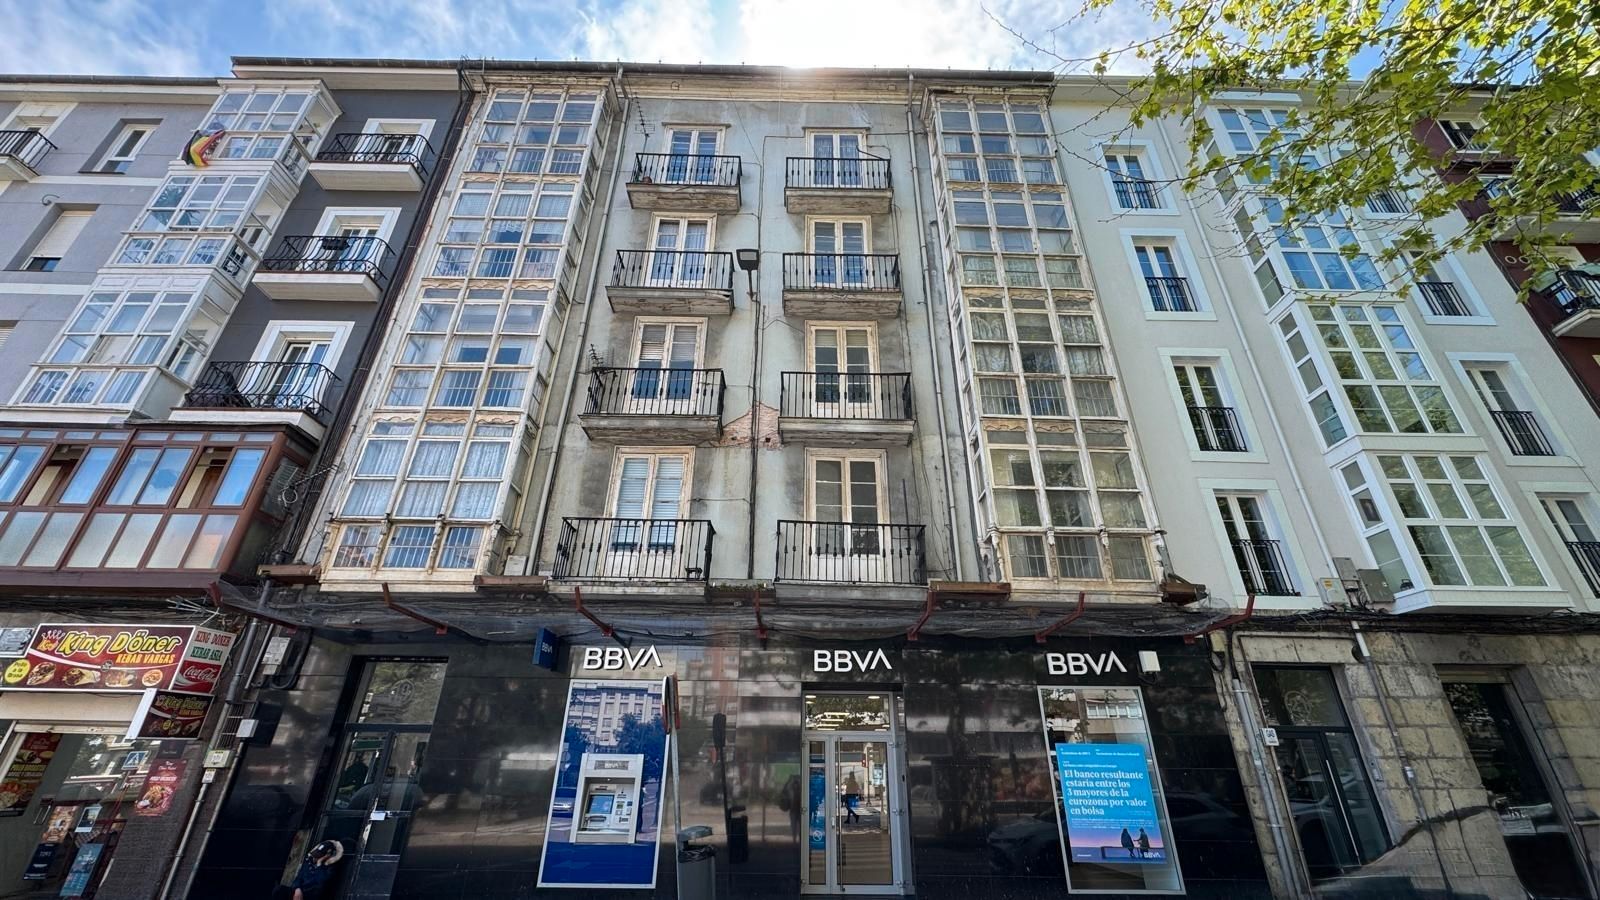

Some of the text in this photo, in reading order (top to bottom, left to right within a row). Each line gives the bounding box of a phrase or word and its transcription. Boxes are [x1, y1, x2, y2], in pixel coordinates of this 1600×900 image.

[56, 631, 109, 656] King
[108, 629, 181, 653] Döner
[195, 631, 211, 644] KING
[541, 642, 553, 654] BBVA
[116, 653, 177, 664] KEBAB VARGAS
[583, 644, 663, 671] BBVA
[813, 648, 892, 672] BBVA
[1046, 650, 1128, 675] BBVA
[1064, 770, 1144, 779] El banco resultante
[1095, 780, 1118, 788] entre
[1118, 779, 1130, 788] los
[1067, 788, 1129, 798] 3 mayores de la
[1069, 797, 1147, 808] eurozona por valor
[1070, 806, 1105, 815] en bolsa
